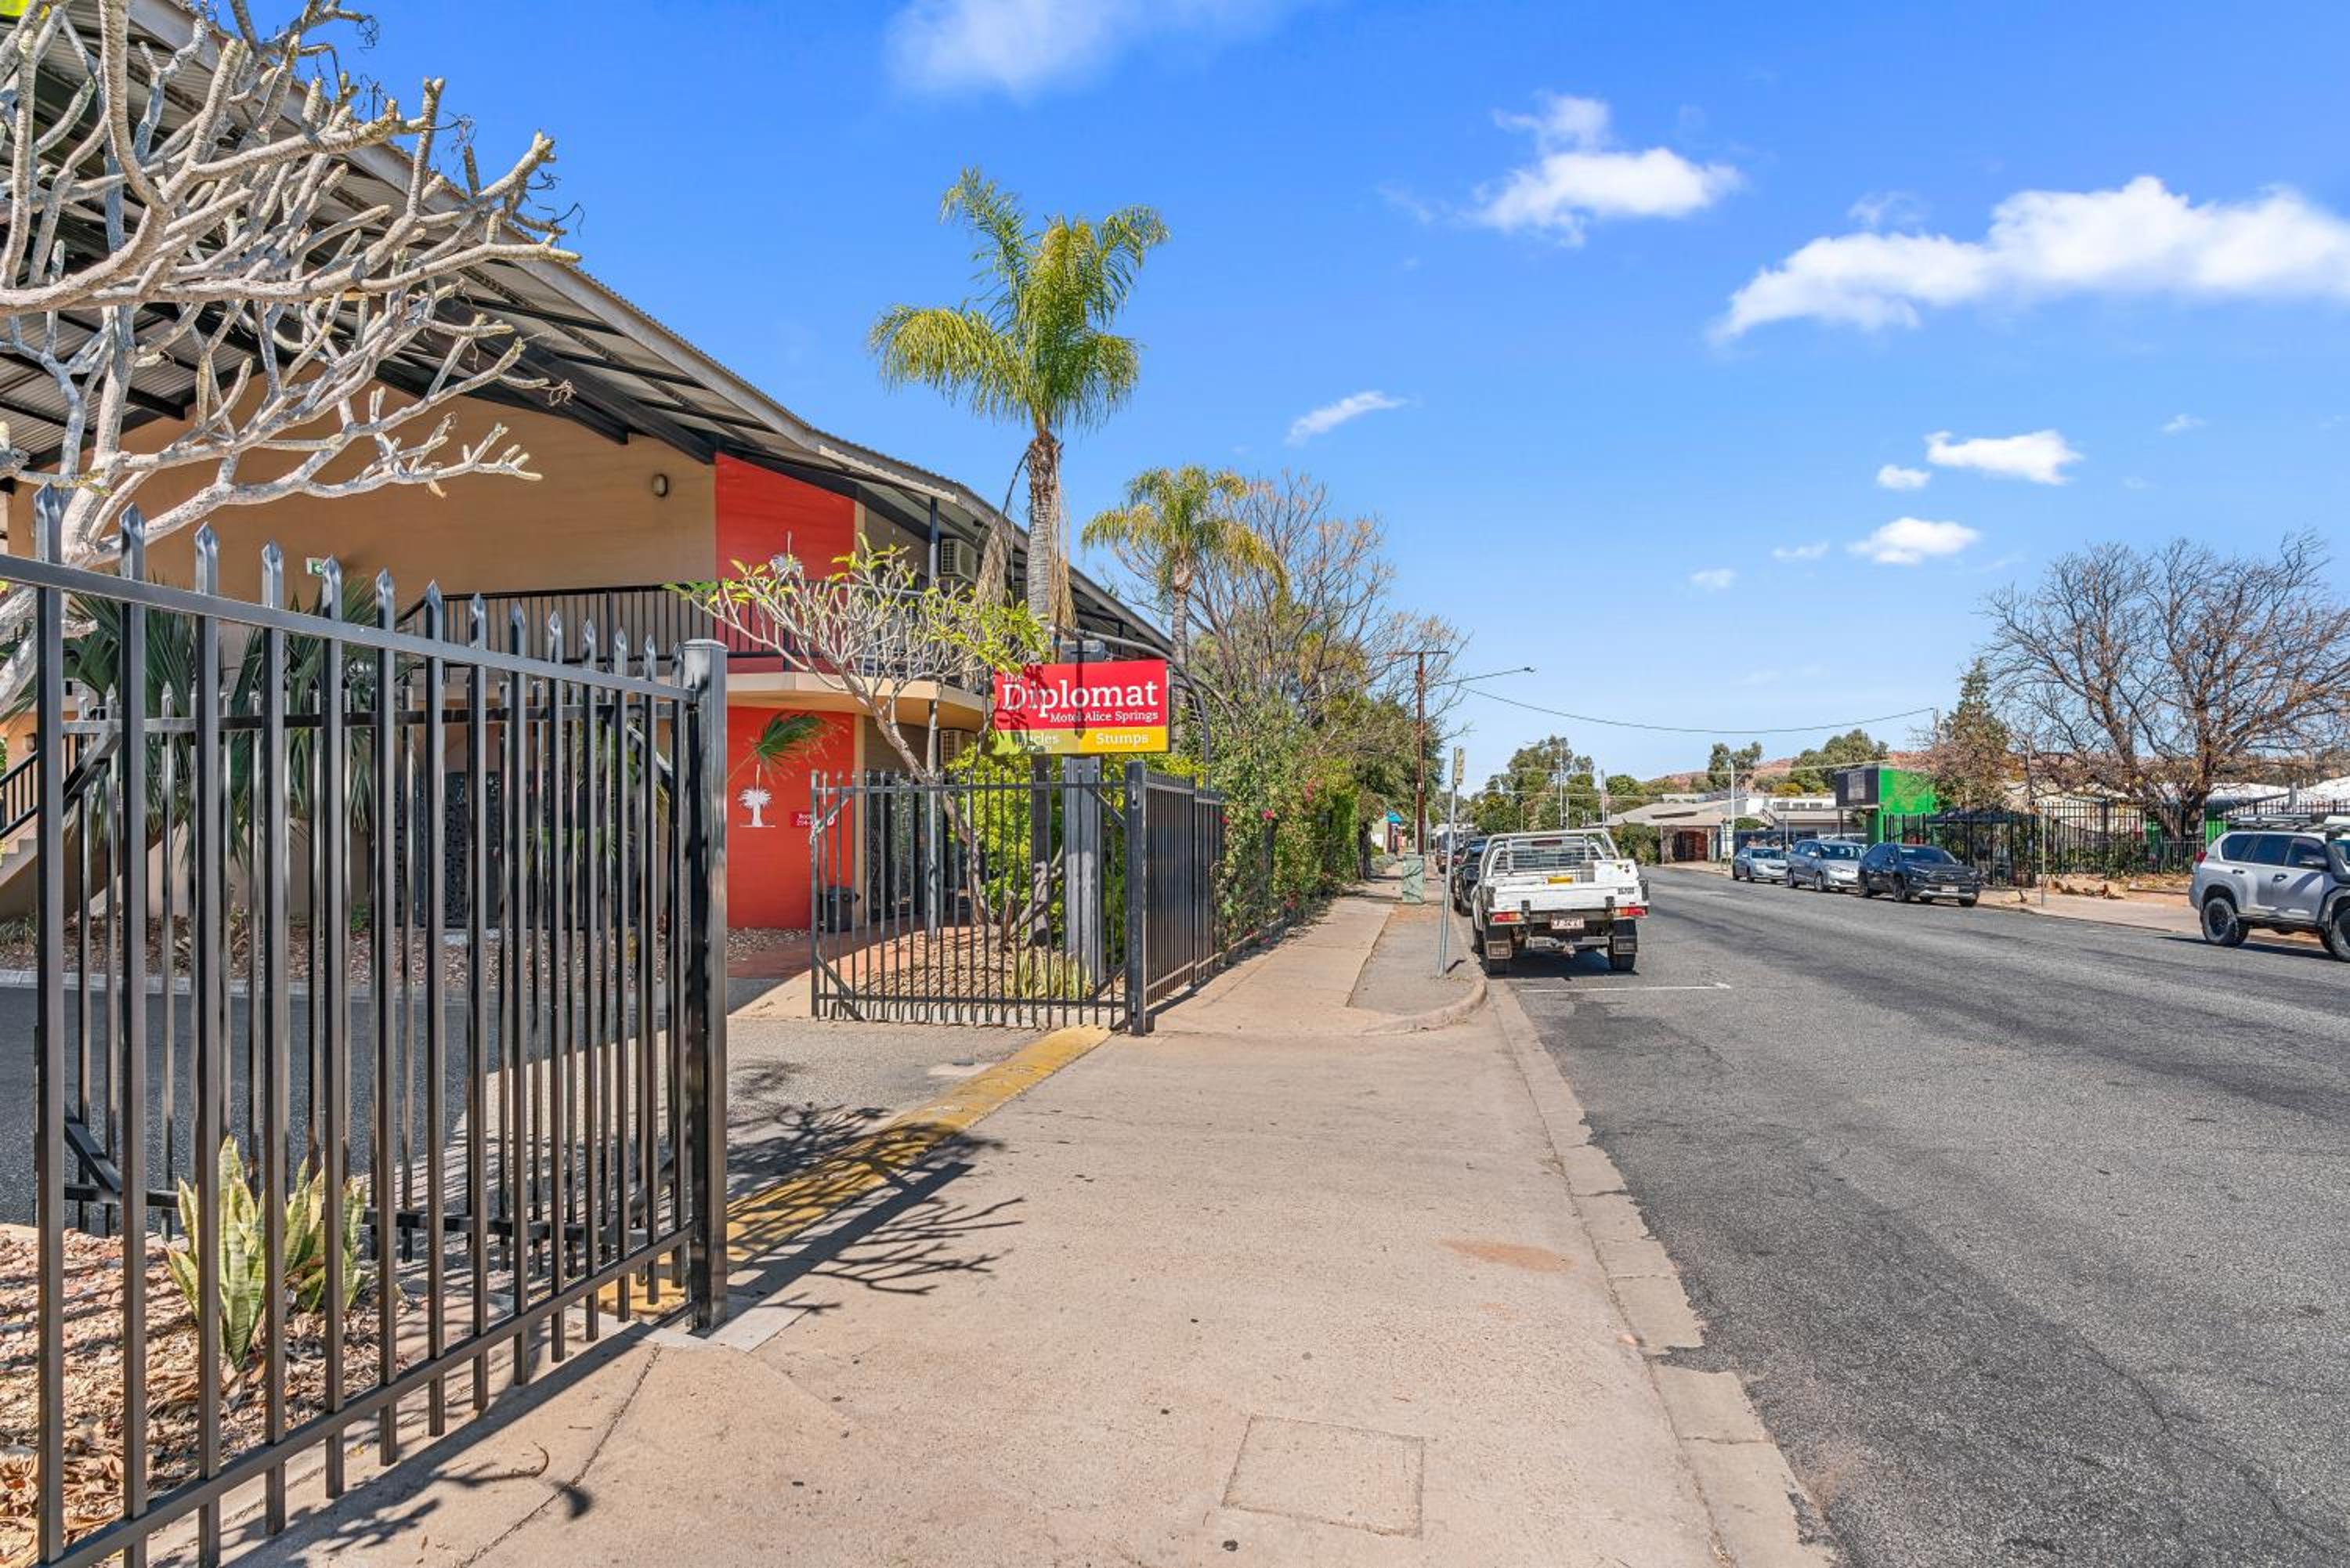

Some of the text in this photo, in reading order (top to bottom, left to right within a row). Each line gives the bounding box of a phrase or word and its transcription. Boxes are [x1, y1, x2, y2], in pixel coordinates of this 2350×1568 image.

[1003, 679, 1159, 718] Diplomat
[1085, 711, 1112, 721] Alice
[1115, 710, 1159, 723] Springs
[1096, 732, 1149, 746] Stumps
